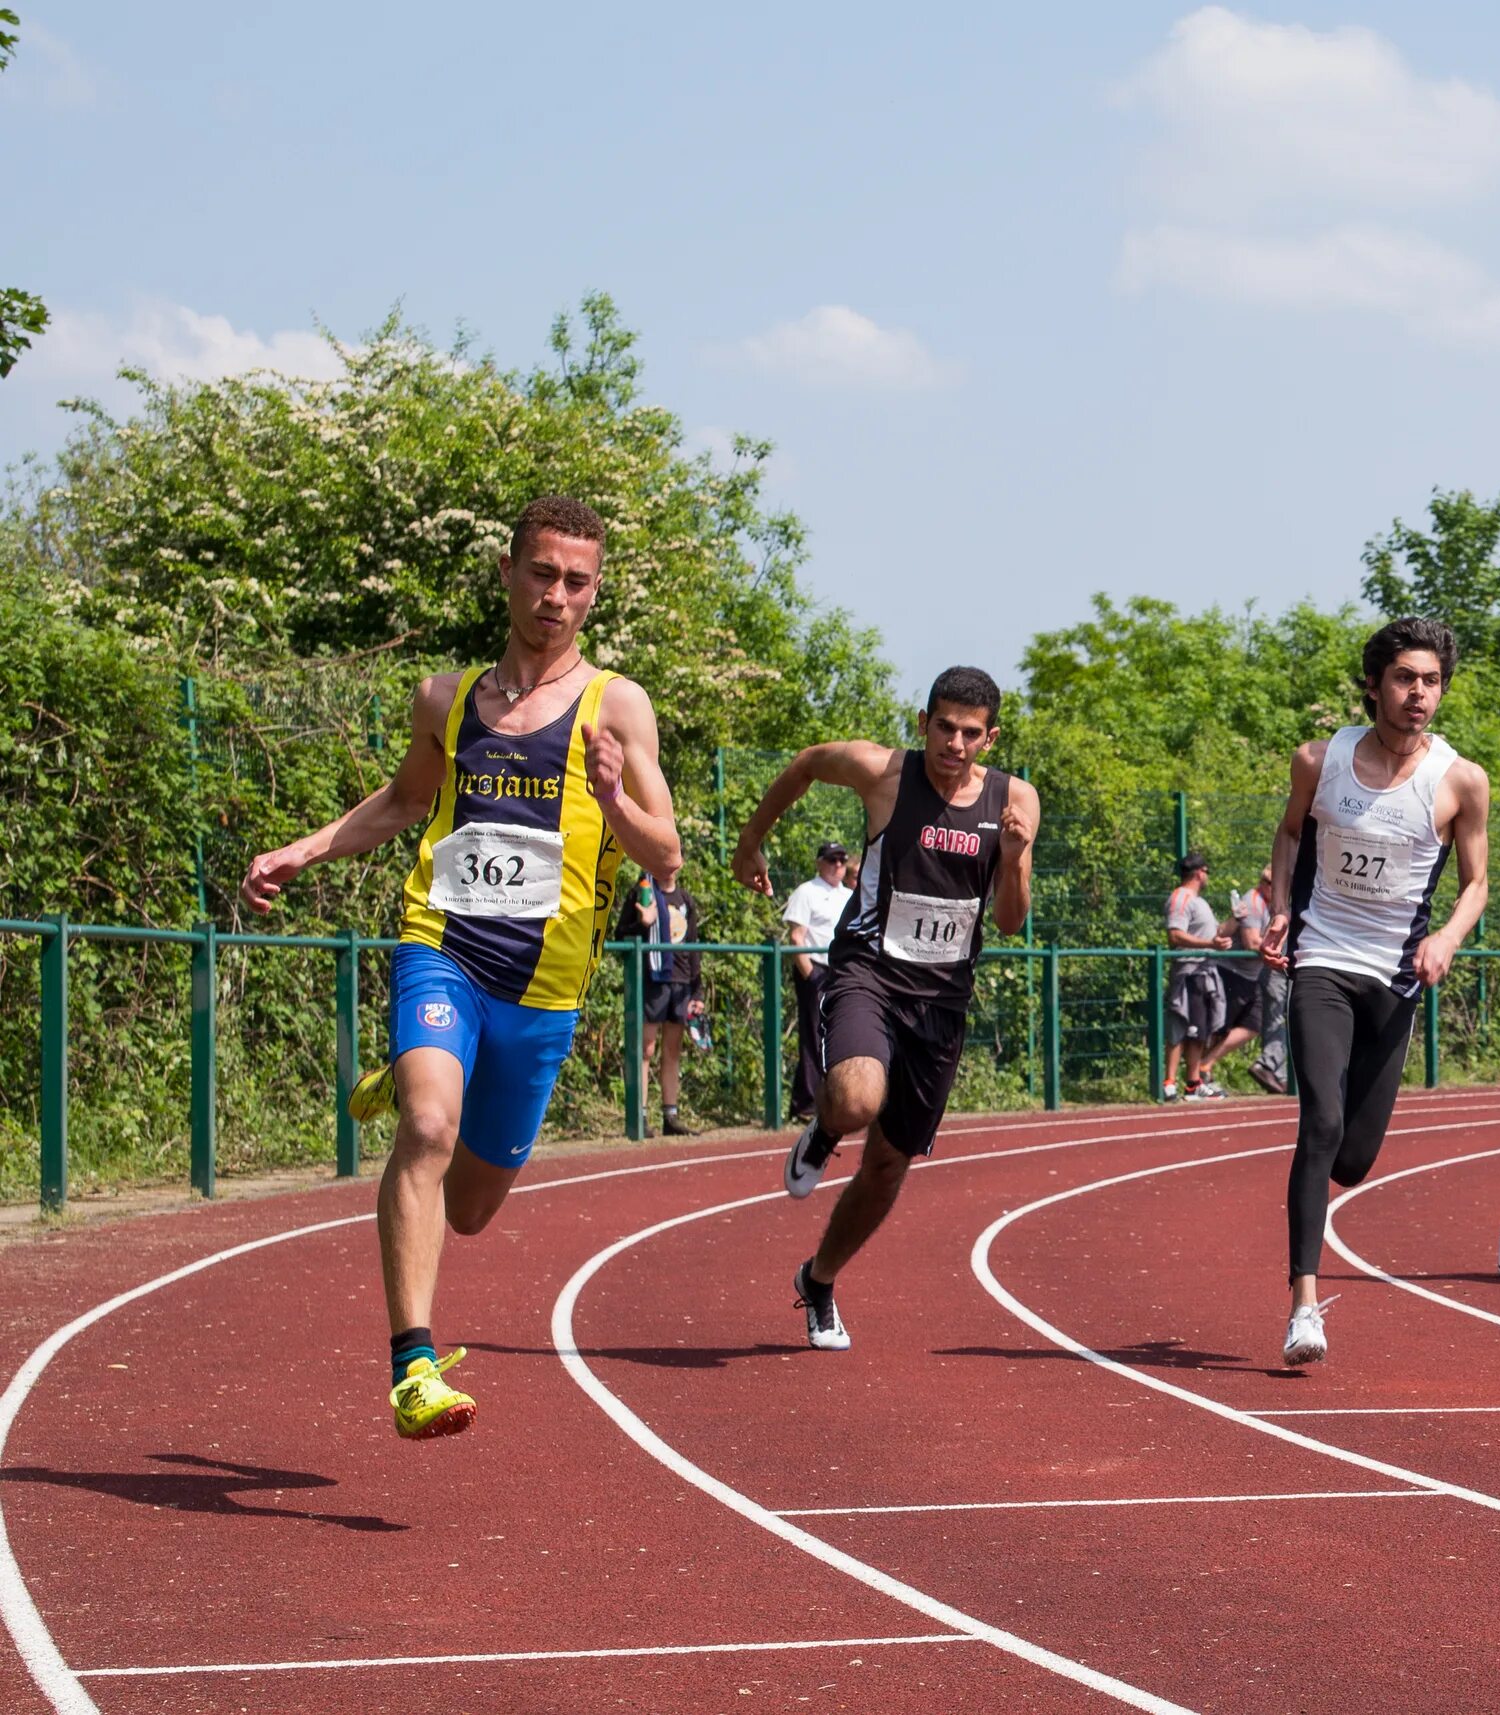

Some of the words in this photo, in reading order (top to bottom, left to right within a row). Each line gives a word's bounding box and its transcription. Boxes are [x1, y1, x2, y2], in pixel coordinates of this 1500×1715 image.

[458, 768, 560, 801] trojans
[1339, 796, 1363, 810] ACS
[920, 825, 981, 856] CAIRO
[461, 853, 526, 887] 362
[1340, 851, 1386, 880] 227
[1335, 878, 1349, 888] ACS
[1350, 882, 1390, 895] Hillingdon
[475, 896, 498, 905] School
[508, 897, 519, 905] the
[521, 897, 544, 907] Hague
[912, 917, 957, 942] 110
